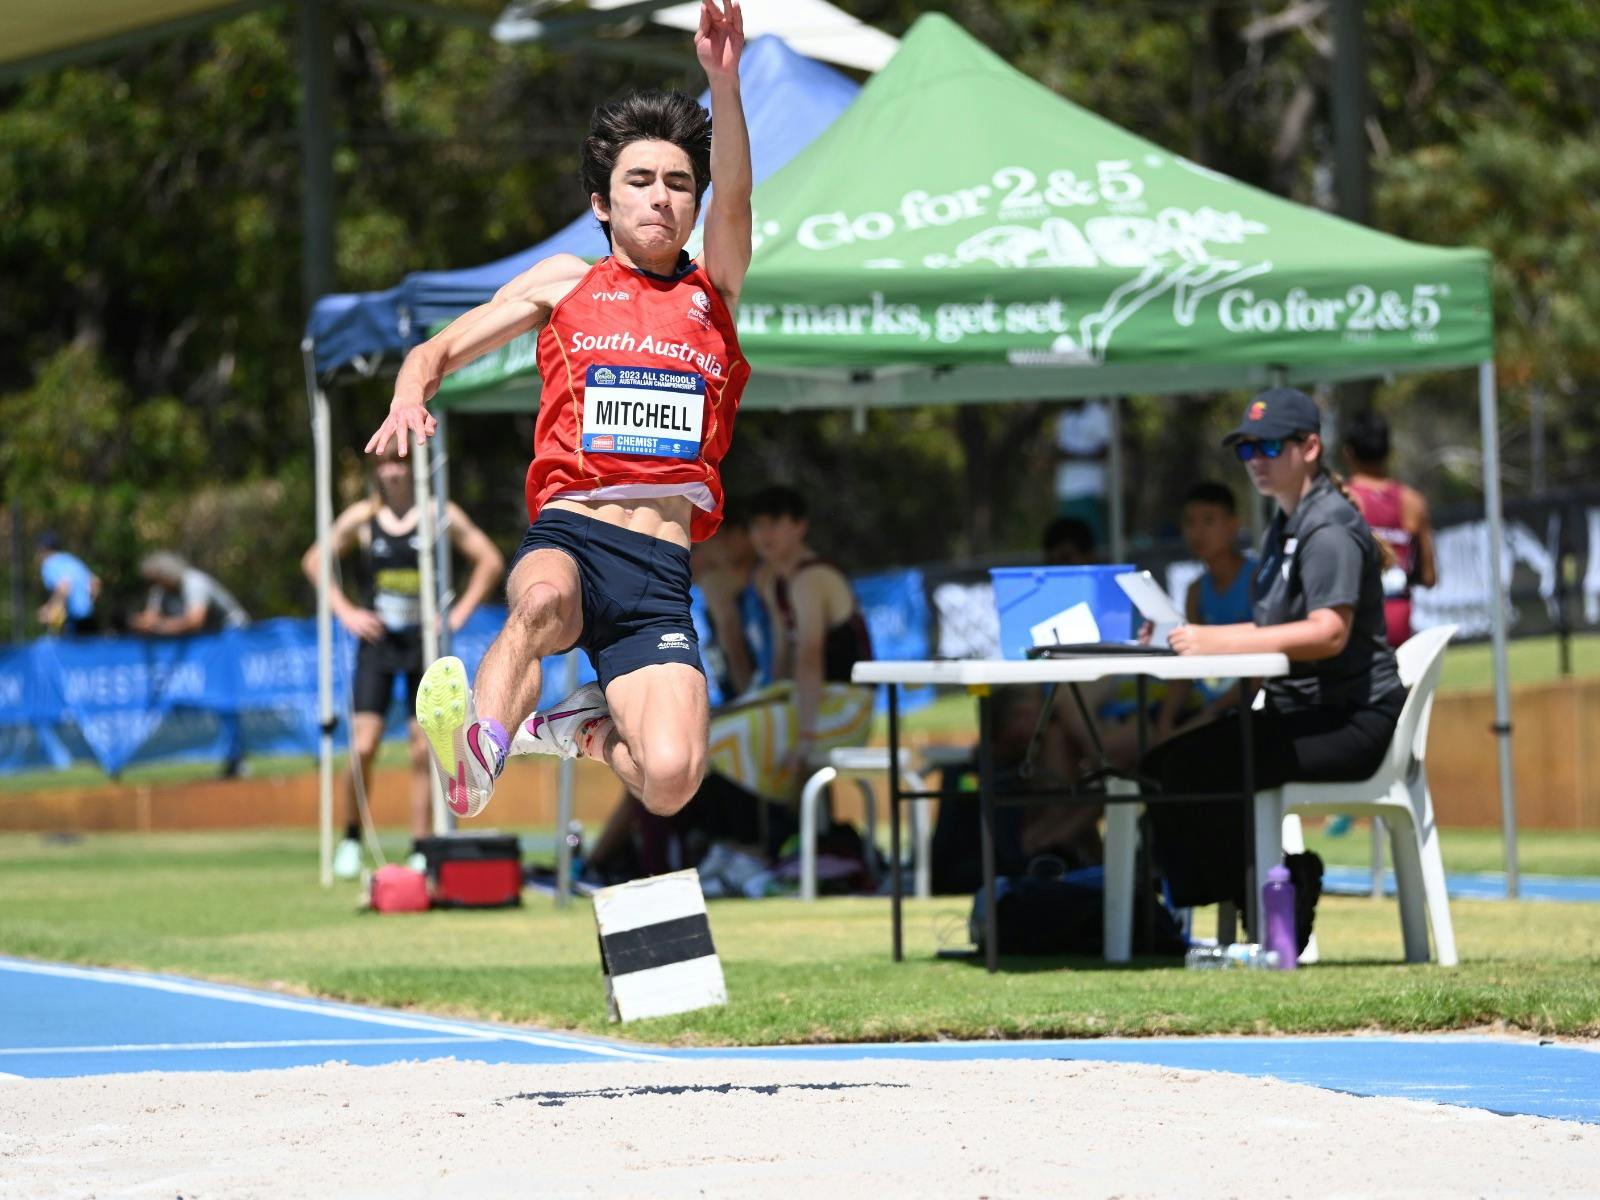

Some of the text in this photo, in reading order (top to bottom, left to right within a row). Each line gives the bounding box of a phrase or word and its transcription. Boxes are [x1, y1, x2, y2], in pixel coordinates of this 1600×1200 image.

[797, 211, 895, 250] Go
[899, 184, 992, 231] for
[780, 291, 931, 341] marks,
[935, 297, 1001, 344] get
[1004, 297, 1068, 334] set
[1218, 288, 1283, 332] Go
[1285, 287, 1344, 331] for
[571, 332, 722, 378] South Australia
[619, 371, 697, 385] 2023 ALL SCHOOLS
[619, 378, 653, 386] AUSTRALIAN
[654, 381, 696, 390] CHAMPIONSHIPS
[596, 401, 691, 431] MITCHELL
[617, 436, 658, 447] CHEMIST
